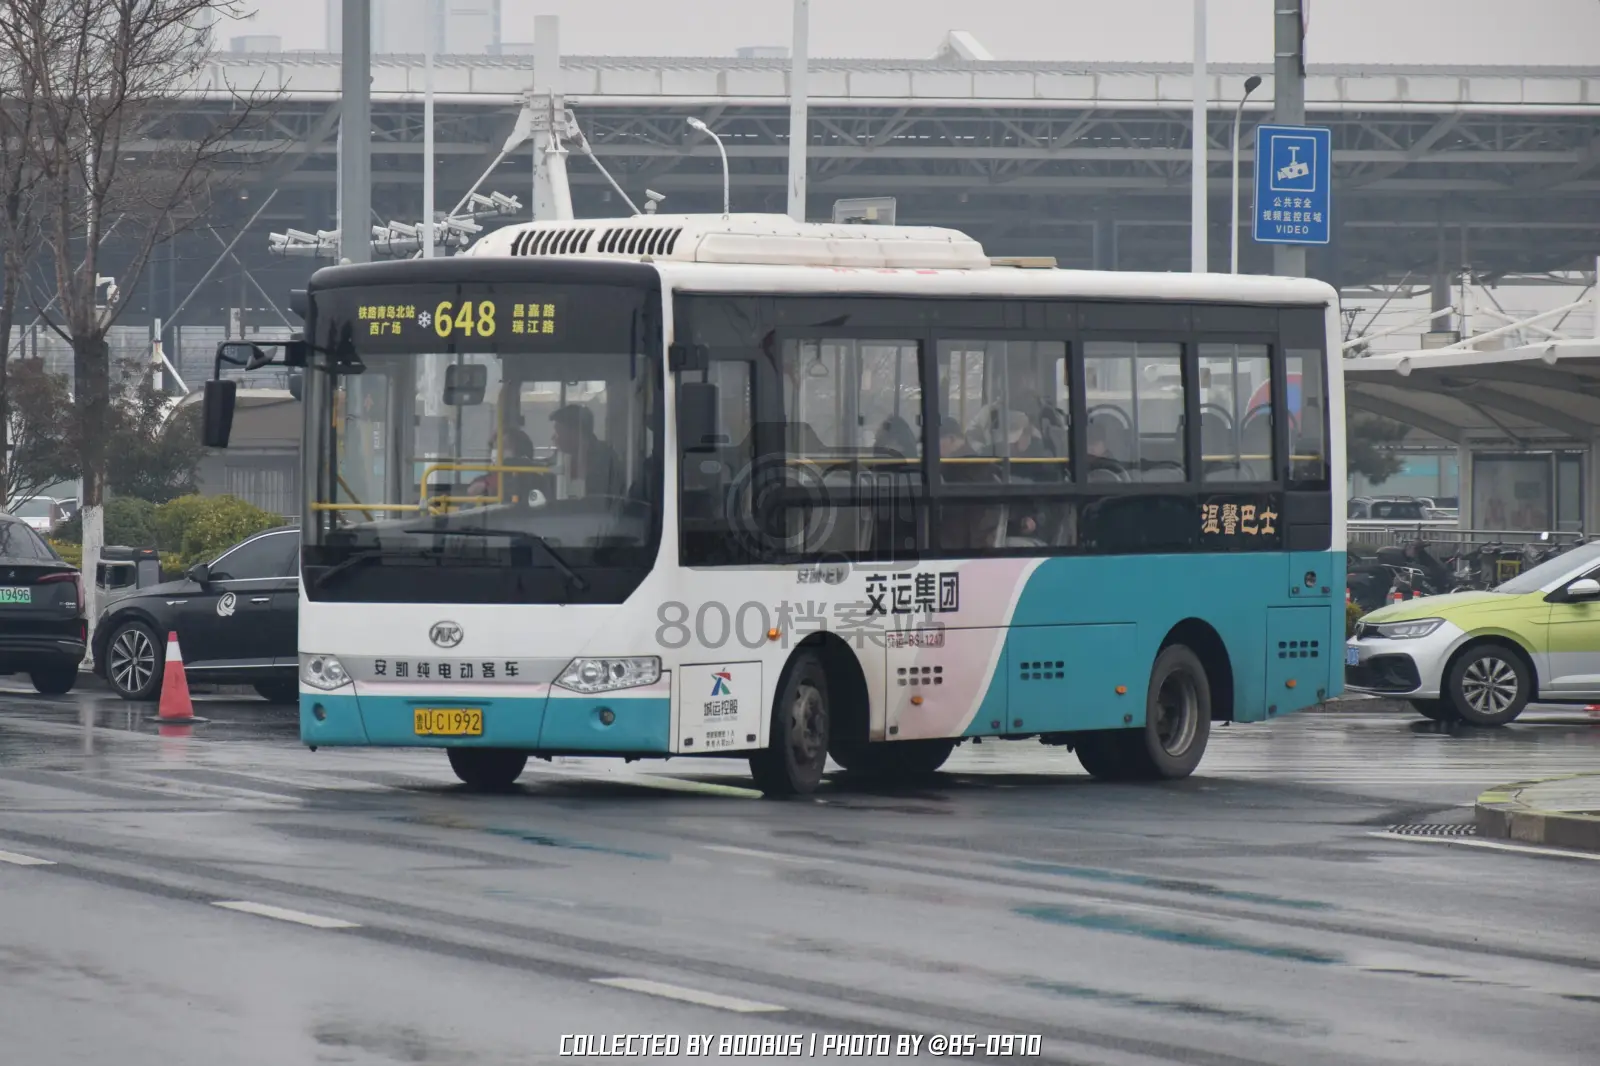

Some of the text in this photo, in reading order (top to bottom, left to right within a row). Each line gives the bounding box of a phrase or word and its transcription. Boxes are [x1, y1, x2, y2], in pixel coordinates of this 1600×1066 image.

[1273, 197, 1312, 209] 公共安全
[1263, 210, 1322, 223] 视频监控区域
[1275, 224, 1309, 234] VIDEO
[358, 304, 416, 319] 铁路青岛北站
[434, 301, 496, 337] 648
[369, 321, 401, 336] 西广场
[1201, 503, 1278, 535] 温馨巴士
[865, 571, 959, 616] 交运集团
[374, 659, 519, 679] 安凯纯电动客车
[703, 698, 738, 716] 城运控股
